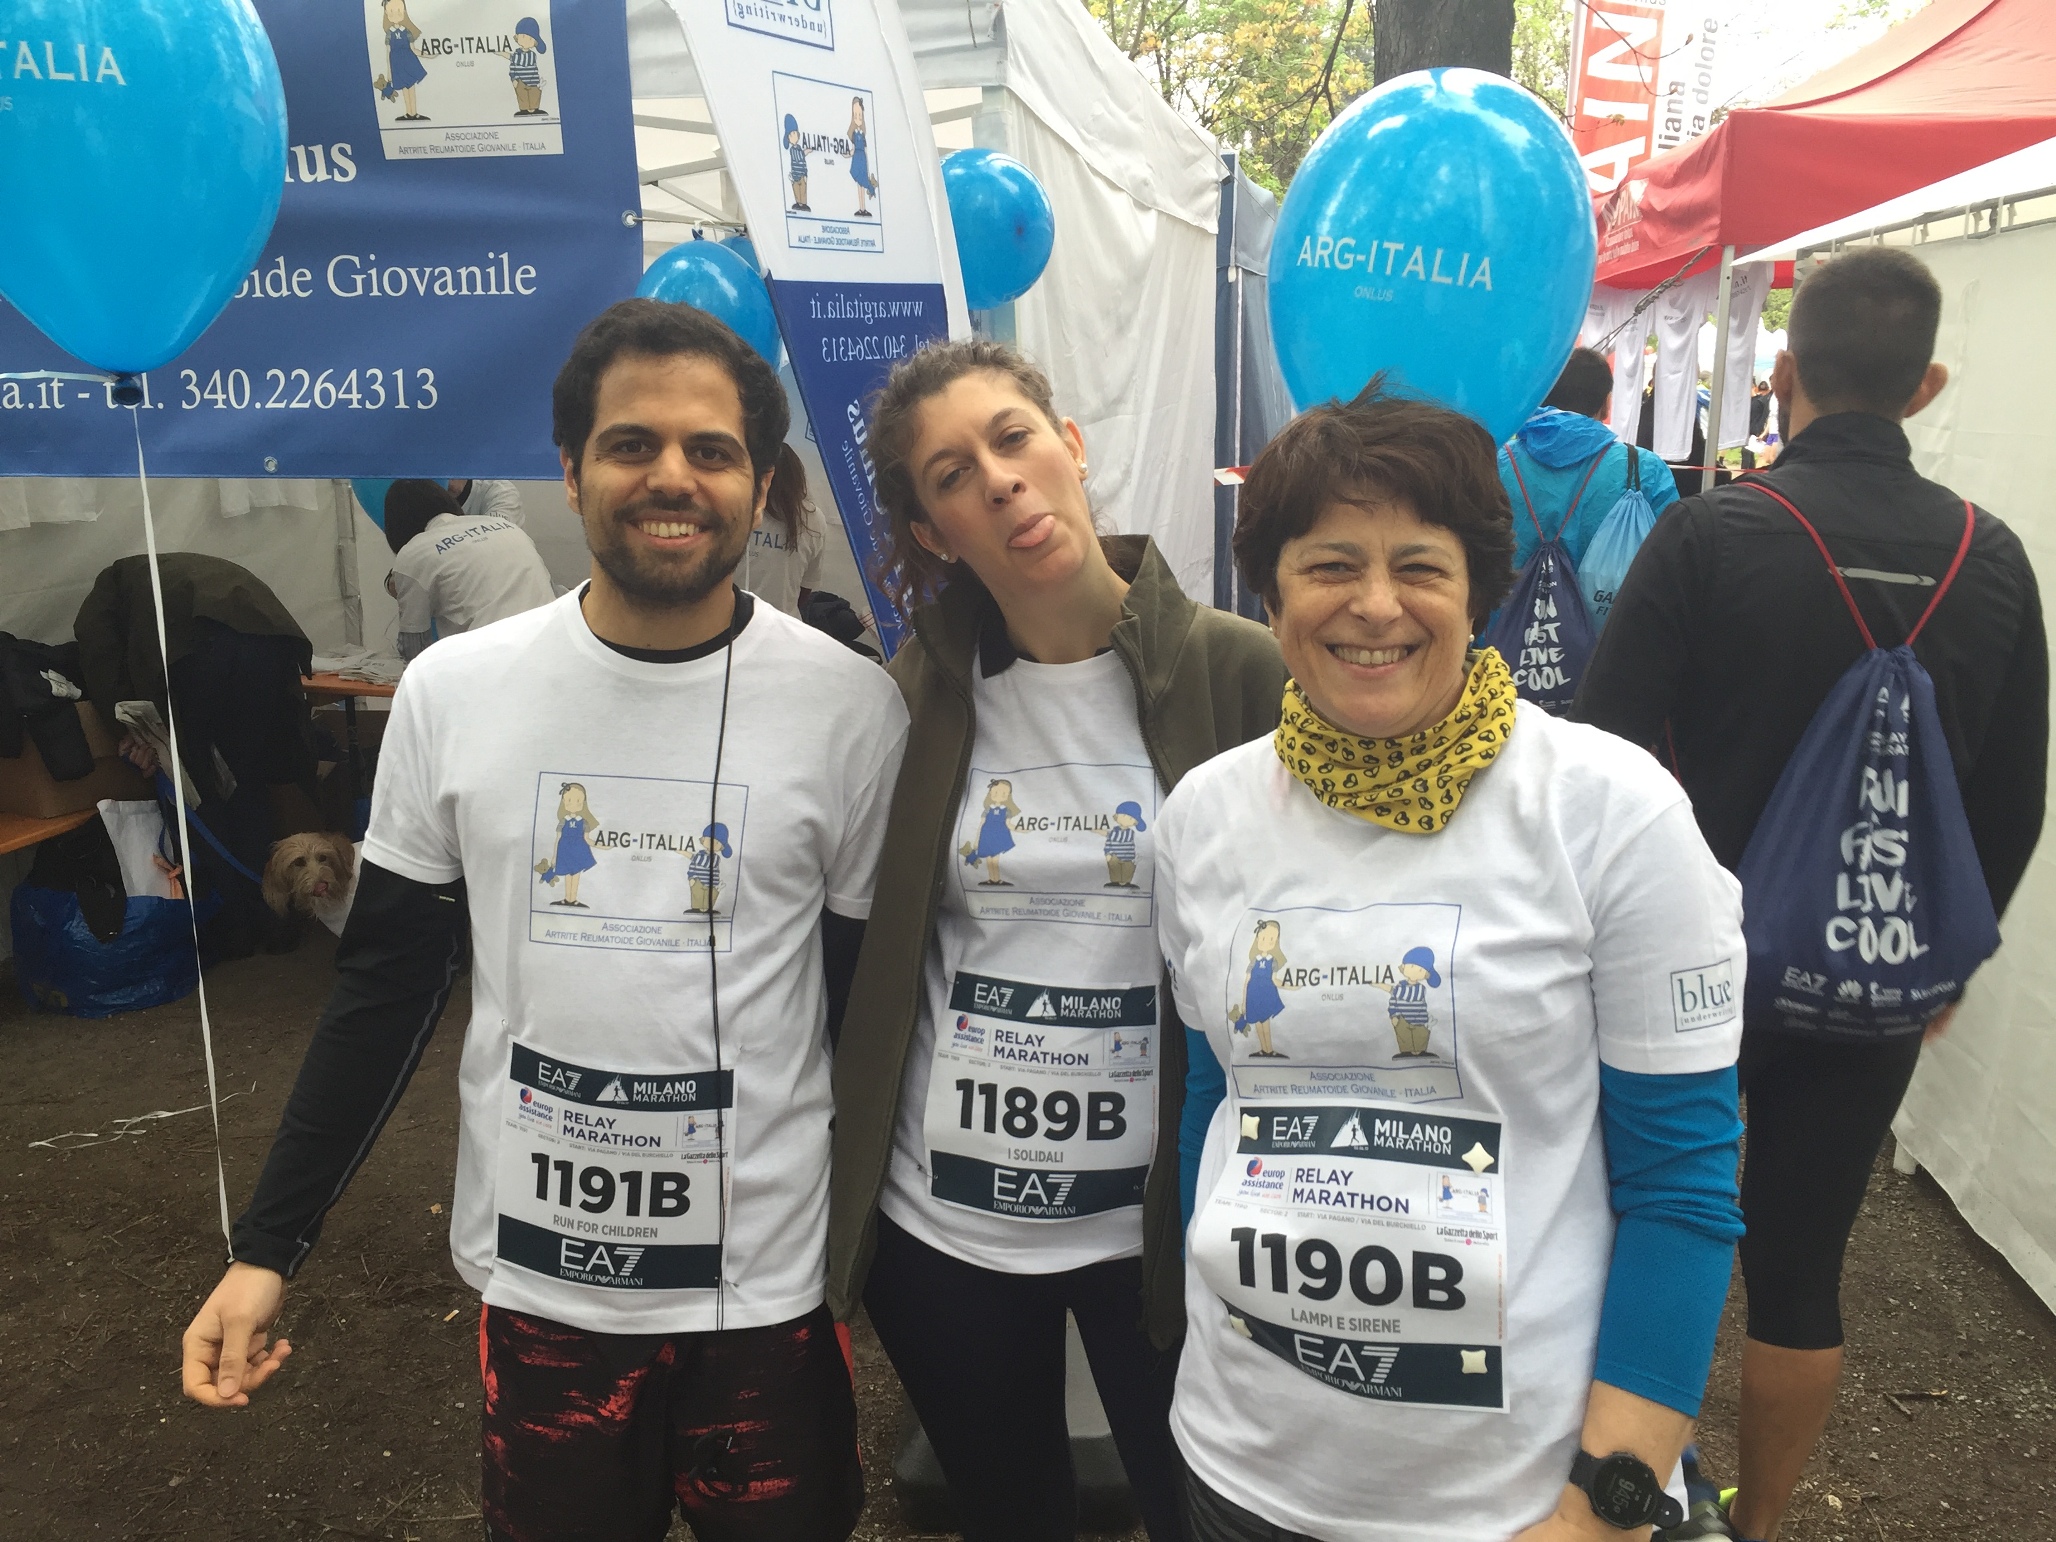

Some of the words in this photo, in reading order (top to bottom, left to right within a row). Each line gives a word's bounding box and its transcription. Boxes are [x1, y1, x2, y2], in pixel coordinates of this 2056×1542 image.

[421, 35, 513, 56] ARG-ITALIA
[0, 39, 127, 86] ALIA
[1692, 18, 1718, 105] dolore
[444, 132, 499, 141] ASSOCIAZIONE
[398, 144, 428, 155] ARTRITE
[429, 144, 476, 154] REUMATOIDE
[477, 142, 517, 152] GIOVANILE
[522, 142, 546, 151] ITALIA
[1296, 235, 1493, 292] ARG-ITALIA
[327, 252, 538, 298] Giovanile
[1354, 285, 1394, 302] ONLUS
[180, 368, 438, 410] 340.2264313
[435, 522, 515, 555] ARG-ITALIA
[1520, 645, 1566, 667] LIVE
[1512, 666, 1572, 692] COOL
[1014, 814, 1110, 831] ARG-ITALIA
[594, 830, 696, 852] ARG-ITALIA
[1029, 896, 1086, 906] ASSOCIAZIONE
[980, 906, 1010, 916] ARTRITE
[1012, 907, 1060, 918] REUMATOIDE
[1062, 908, 1102, 920] GIOVANILE
[1108, 913, 1132, 922] ITALIA
[545, 929, 578, 941] ARTRITE
[580, 932, 634, 945] REUMATOIDE
[636, 936, 681, 947] GIOVANILE
[602, 922, 662, 934] ASSOCIAZIONE
[1825, 916, 1930, 966] COOL
[1282, 964, 1396, 987] ARG-ITALIA
[974, 982, 1015, 1008] EA7
[1060, 994, 1122, 1010] MILANO
[1321, 993, 1344, 1002] ONLUS
[1677, 974, 1732, 1013] blue
[1060, 1008, 1122, 1019] MARATHON
[954, 1032, 984, 1044] assistance
[968, 1026, 986, 1036] europ
[995, 1029, 1045, 1048] RELAY
[994, 1045, 1088, 1066] MARATHON
[538, 1060, 582, 1091] EA7
[1310, 1071, 1376, 1082] ASSOCIAZIONE
[633, 1093, 696, 1102] MARATHON
[634, 1080, 696, 1095] MILANO
[1253, 1084, 1288, 1094] ARTRITE
[1290, 1084, 1348, 1095] REUMATOIDE
[1350, 1084, 1396, 1098] GIOVANILE
[1404, 1086, 1437, 1098] ITALIA
[518, 1104, 553, 1122] assistance
[532, 1100, 554, 1114] europ
[956, 1078, 1128, 1141] 1189B
[564, 1109, 616, 1130] RELAY
[1272, 1115, 1319, 1141] EA7
[1374, 1118, 1452, 1142] MILANO
[562, 1126, 662, 1148] MARATHON
[1374, 1136, 1452, 1156] MARATHON
[1008, 1148, 1011, 1160] I
[1014, 1148, 1064, 1163] SOLIDALI
[1242, 1178, 1284, 1190] assistance
[1262, 1168, 1286, 1180] europ
[1295, 1168, 1354, 1186] RELAY
[531, 1152, 690, 1218] 1191B
[994, 1168, 1078, 1206] EA7
[994, 1200, 1032, 1214] EMPORIO
[1042, 1206, 1076, 1215] ARMANI
[1292, 1188, 1410, 1214] MARATHON
[553, 1214, 575, 1229] RUN
[576, 1220, 599, 1234] FOR
[601, 1225, 658, 1238] CHILDREN
[1328, 1214, 1355, 1224] PAGANO
[1386, 1220, 1426, 1230] BURCHIELLO
[1436, 1226, 1444, 1236] La
[1444, 1226, 1468, 1238] Gazzetta
[1468, 1230, 1482, 1238] dello
[1482, 1230, 1498, 1241] Sport
[560, 1238, 646, 1276] EA7
[560, 1268, 598, 1282] EMPORIO
[608, 1276, 644, 1286] ARMANI
[1230, 1226, 1466, 1312] 1190B
[1291, 1308, 1333, 1328] LAMPI
[1338, 1316, 1346, 1330] E
[1348, 1318, 1401, 1334] SIRENE
[1294, 1334, 1400, 1384] EA7
[1300, 1362, 1346, 1386] EMPORIO
[1360, 1383, 1402, 1398] ARMANI
